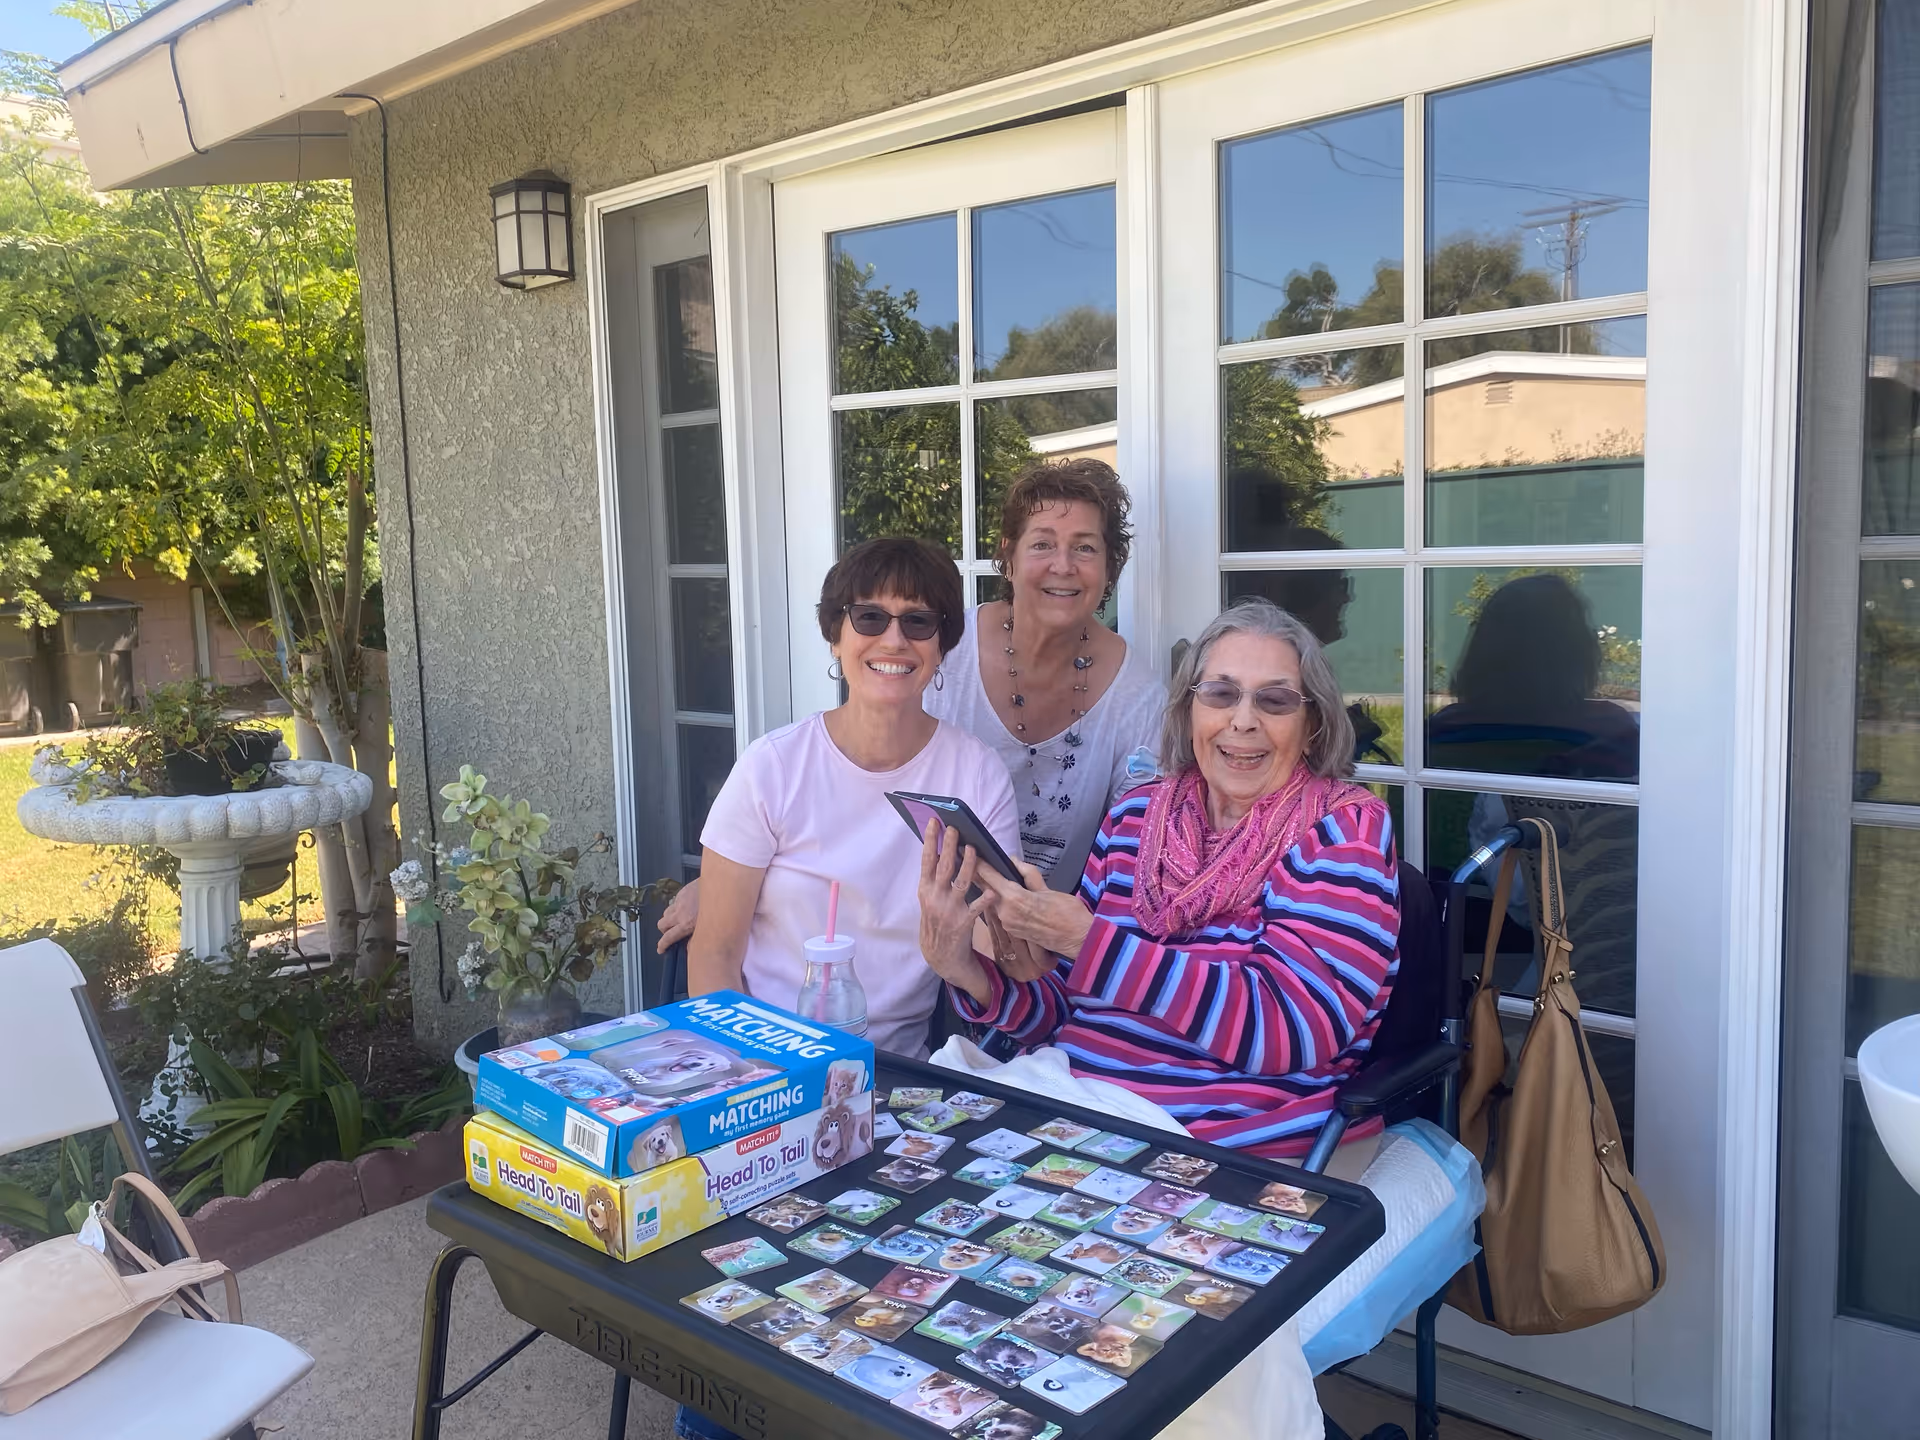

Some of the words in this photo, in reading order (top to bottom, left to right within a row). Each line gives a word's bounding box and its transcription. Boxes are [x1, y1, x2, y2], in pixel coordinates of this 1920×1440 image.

[679, 999, 836, 1058] MATCHING
[685, 1015, 701, 1023] my
[700, 1019, 722, 1031] first
[720, 1027, 756, 1046] memory
[753, 1043, 782, 1055] game
[620, 1068, 651, 1084] puppy
[709, 1084, 804, 1134] MATCHING
[724, 1128, 734, 1137] my
[735, 1122, 749, 1133] first
[749, 1114, 773, 1129] memory
[774, 1109, 790, 1120] game
[740, 1136, 765, 1153] MATCH
[522, 1152, 543, 1167] MATCH
[707, 1160, 753, 1198] Head
[758, 1155, 776, 1175] To
[780, 1137, 805, 1165] Tail
[499, 1161, 536, 1193] Head
[538, 1178, 554, 1202] To
[557, 1186, 581, 1214] Tail
[729, 1184, 767, 1205] self-correcting
[768, 1176, 786, 1189] puzzle
[786, 1171, 796, 1180] sets
[1160, 1182, 1201, 1197] orangutan
[1135, 1207, 1162, 1219] monkey
[907, 1229, 931, 1239] koala
[1189, 1228, 1214, 1239] piglet
[962, 1241, 992, 1252] monkey
[904, 1265, 949, 1279] orangutan
[985, 1280, 1012, 1293] guinea
[1011, 1288, 1028, 1298] pig
[1087, 1277, 1114, 1288] puppy
[1210, 1278, 1235, 1289] chick
[786, 1303, 817, 1319] raccoon
[883, 1299, 907, 1310] chick
[969, 1308, 987, 1316] owl
[897, 1354, 916, 1366] seal
[1076, 1361, 1112, 1380] penguin
[951, 1378, 980, 1393] piglet
